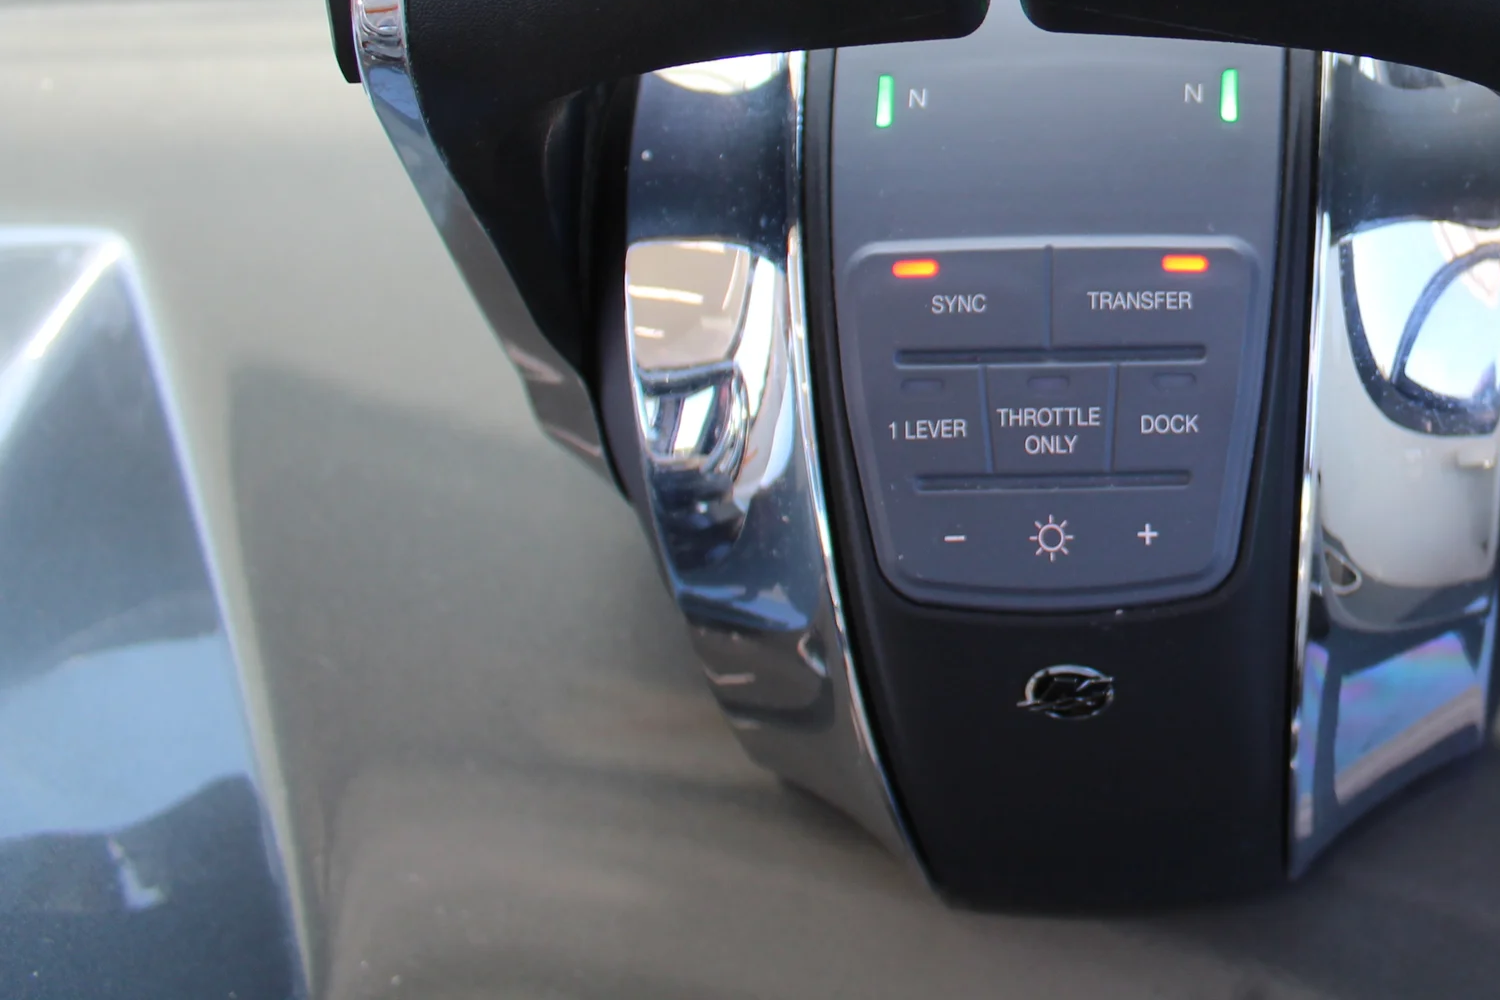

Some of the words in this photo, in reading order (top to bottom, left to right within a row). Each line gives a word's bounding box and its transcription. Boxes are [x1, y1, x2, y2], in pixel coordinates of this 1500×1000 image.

[908, 88, 928, 108] N
[1183, 84, 1203, 103] N
[930, 293, 988, 315] SYNC
[1087, 291, 1193, 311] TRANSFER
[996, 407, 1101, 428] THROTTLE
[1139, 414, 1200, 435] DOCK
[889, 421, 897, 440] 1
[904, 418, 967, 440] LEVER
[1024, 434, 1078, 456] ONLY
